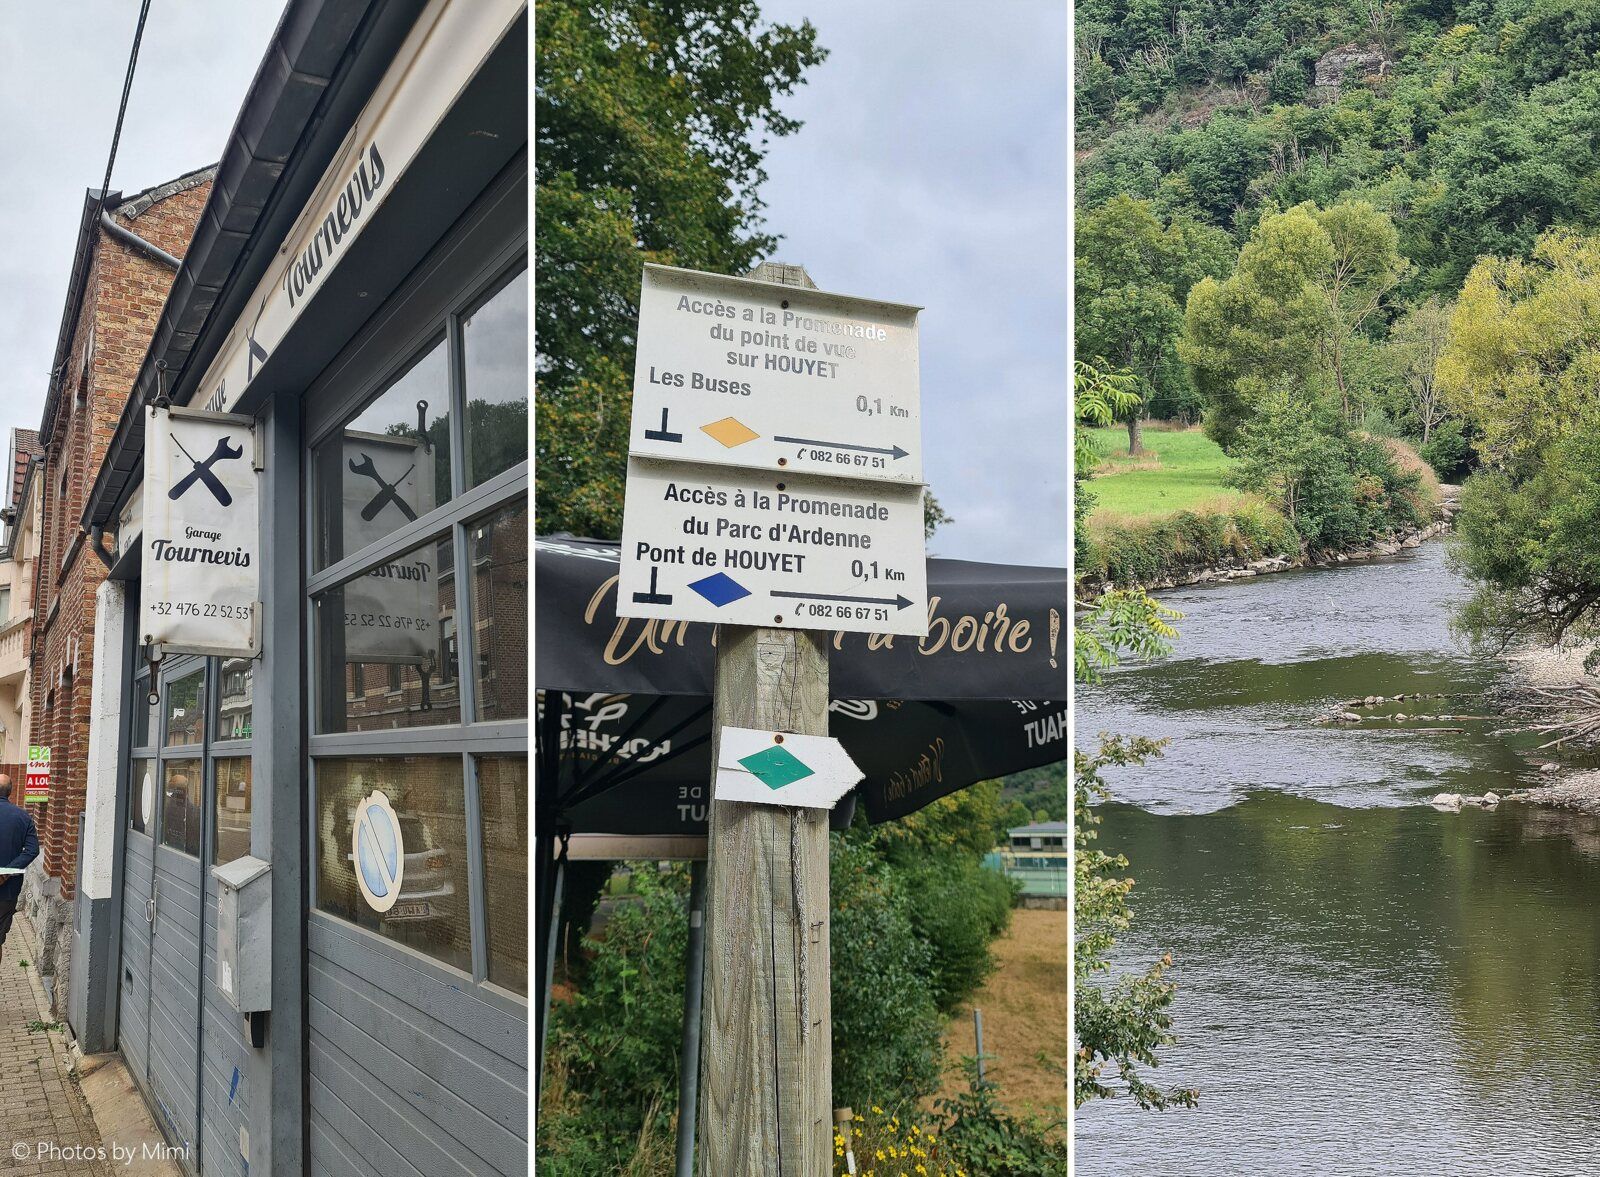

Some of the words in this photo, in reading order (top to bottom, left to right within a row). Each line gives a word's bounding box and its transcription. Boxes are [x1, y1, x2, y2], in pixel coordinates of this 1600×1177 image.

[283, 141, 385, 309] Tournevis
[677, 295, 736, 318] Accès
[760, 310, 776, 325] la
[783, 311, 887, 341] Promenade
[710, 324, 734, 341] du
[741, 330, 789, 351] point
[795, 335, 817, 353] de
[823, 342, 856, 360] vue
[727, 351, 758, 367] sur
[765, 353, 839, 379] HOUYET
[650, 366, 684, 387] Les
[691, 372, 751, 396] Buses
[856, 395, 884, 416] 0,1
[810, 449, 832, 463] 082
[836, 453, 850, 465] 66
[854, 455, 868, 467] 67
[872, 457, 886, 469] 51
[664, 483, 727, 506] Accès
[734, 489, 746, 508] à
[753, 491, 770, 510] la
[777, 493, 889, 521] Promenade
[185, 526, 222, 542] Garage
[683, 516, 709, 536] du
[716, 518, 762, 540] Parc
[769, 522, 872, 549] d'Ardenne
[151, 539, 250, 568] Tournevis
[636, 542, 685, 564] Pont
[692, 547, 717, 567] de
[724, 549, 806, 574] HOUYET
[851, 559, 879, 582] 0,1
[885, 568, 905, 581] Km
[150, 602, 172, 616] +32
[176, 602, 200, 616] 476
[203, 603, 217, 617] 22
[220, 605, 233, 619] 52
[236, 606, 249, 620] 53
[808, 603, 832, 617] 082
[836, 605, 852, 619] 66
[855, 607, 871, 620] 67
[875, 608, 889, 621] 51
[918, 596, 1032, 656] boire
[27, 777, 33, 785] A
